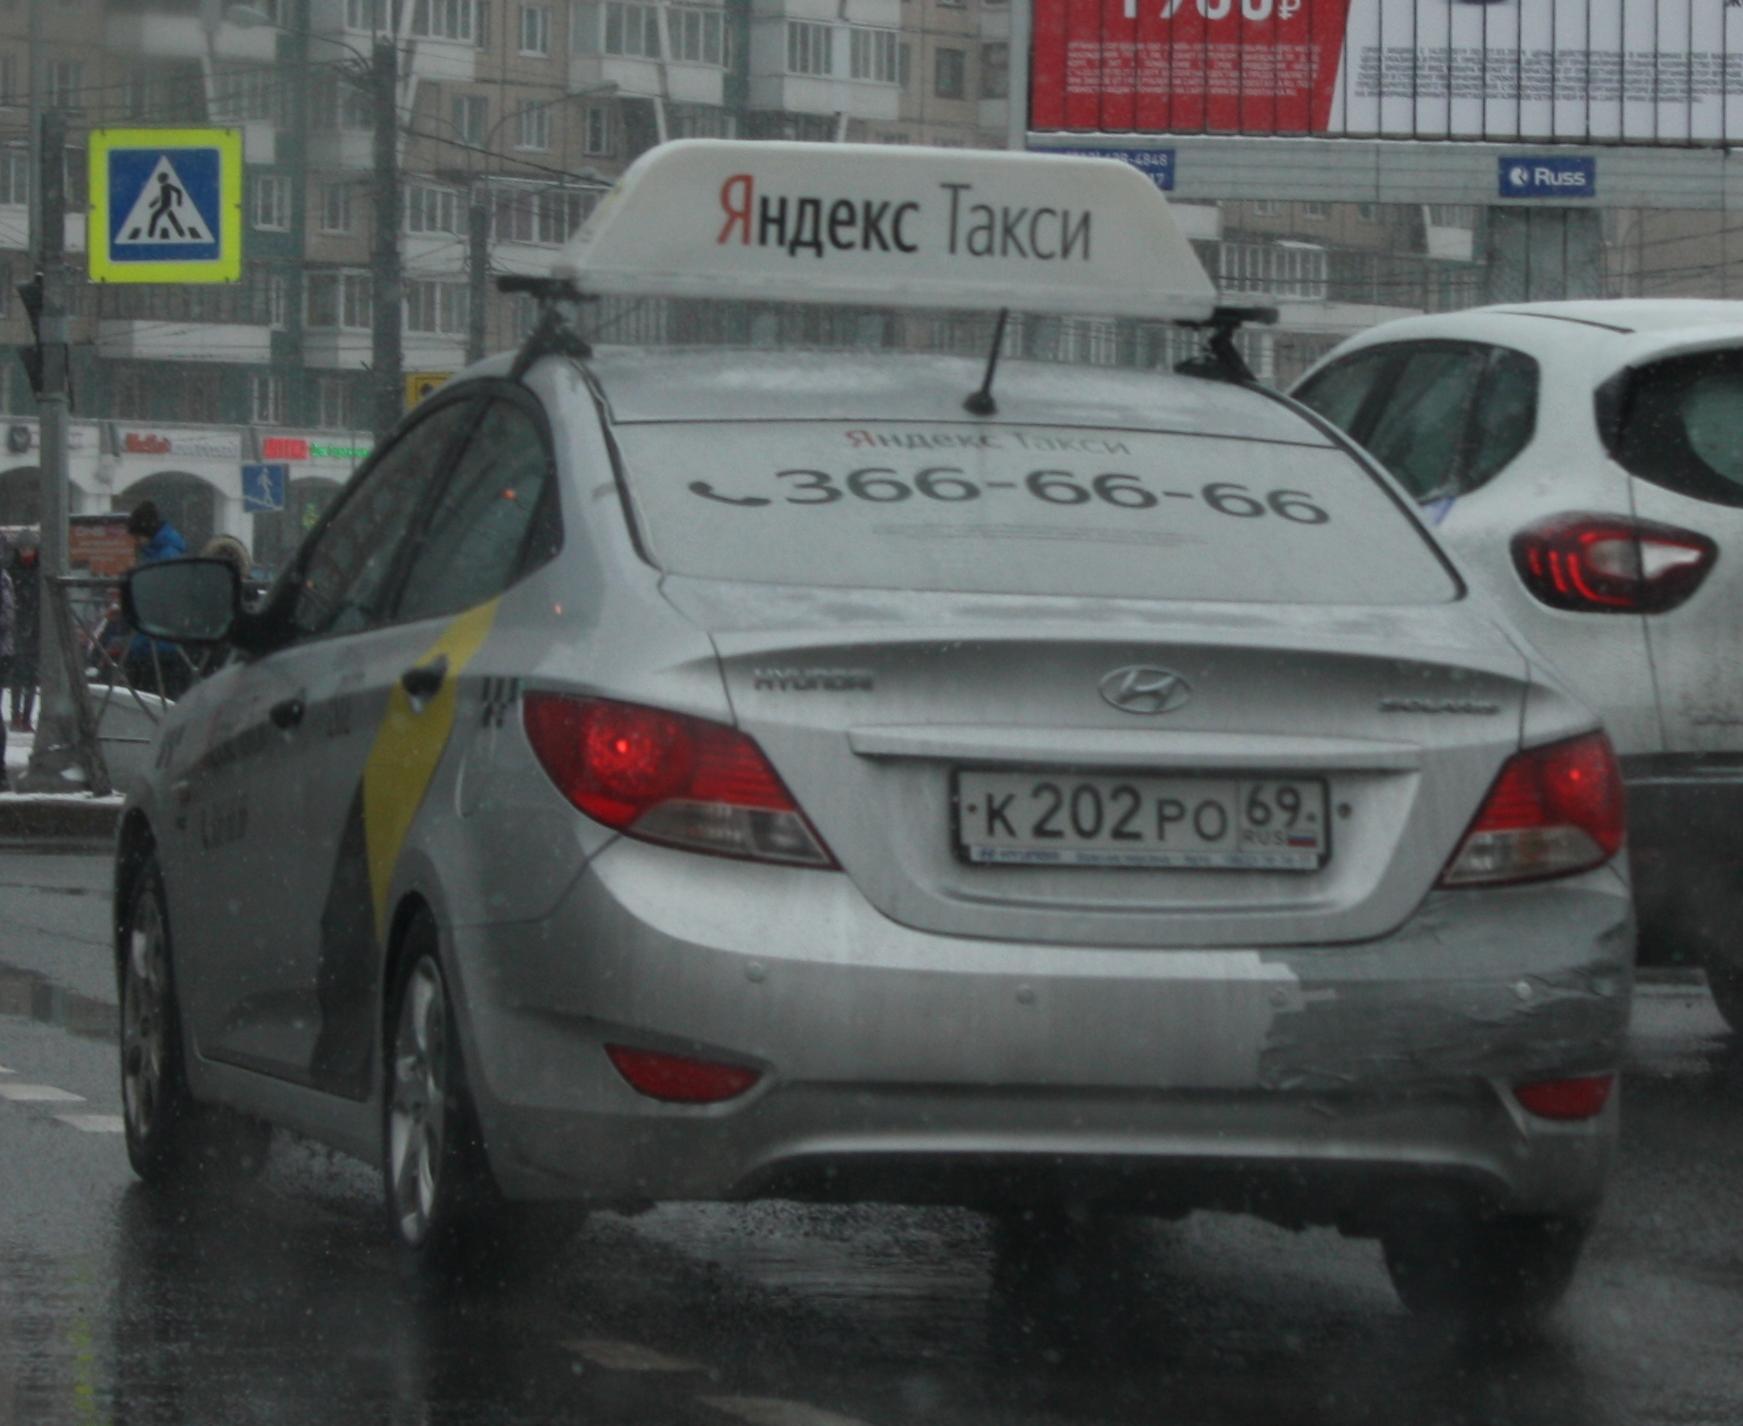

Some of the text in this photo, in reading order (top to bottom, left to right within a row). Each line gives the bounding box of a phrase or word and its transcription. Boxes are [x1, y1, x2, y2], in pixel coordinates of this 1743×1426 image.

[1534, 167, 1586, 186] Russ
[717, 173, 1092, 261] Яндекс Такси
[845, 429, 1131, 455] Яндекс Такси
[775, 466, 1331, 526] 366-66-66
[1245, 782, 1301, 827] 69
[1244, 830, 1285, 846] RUS
